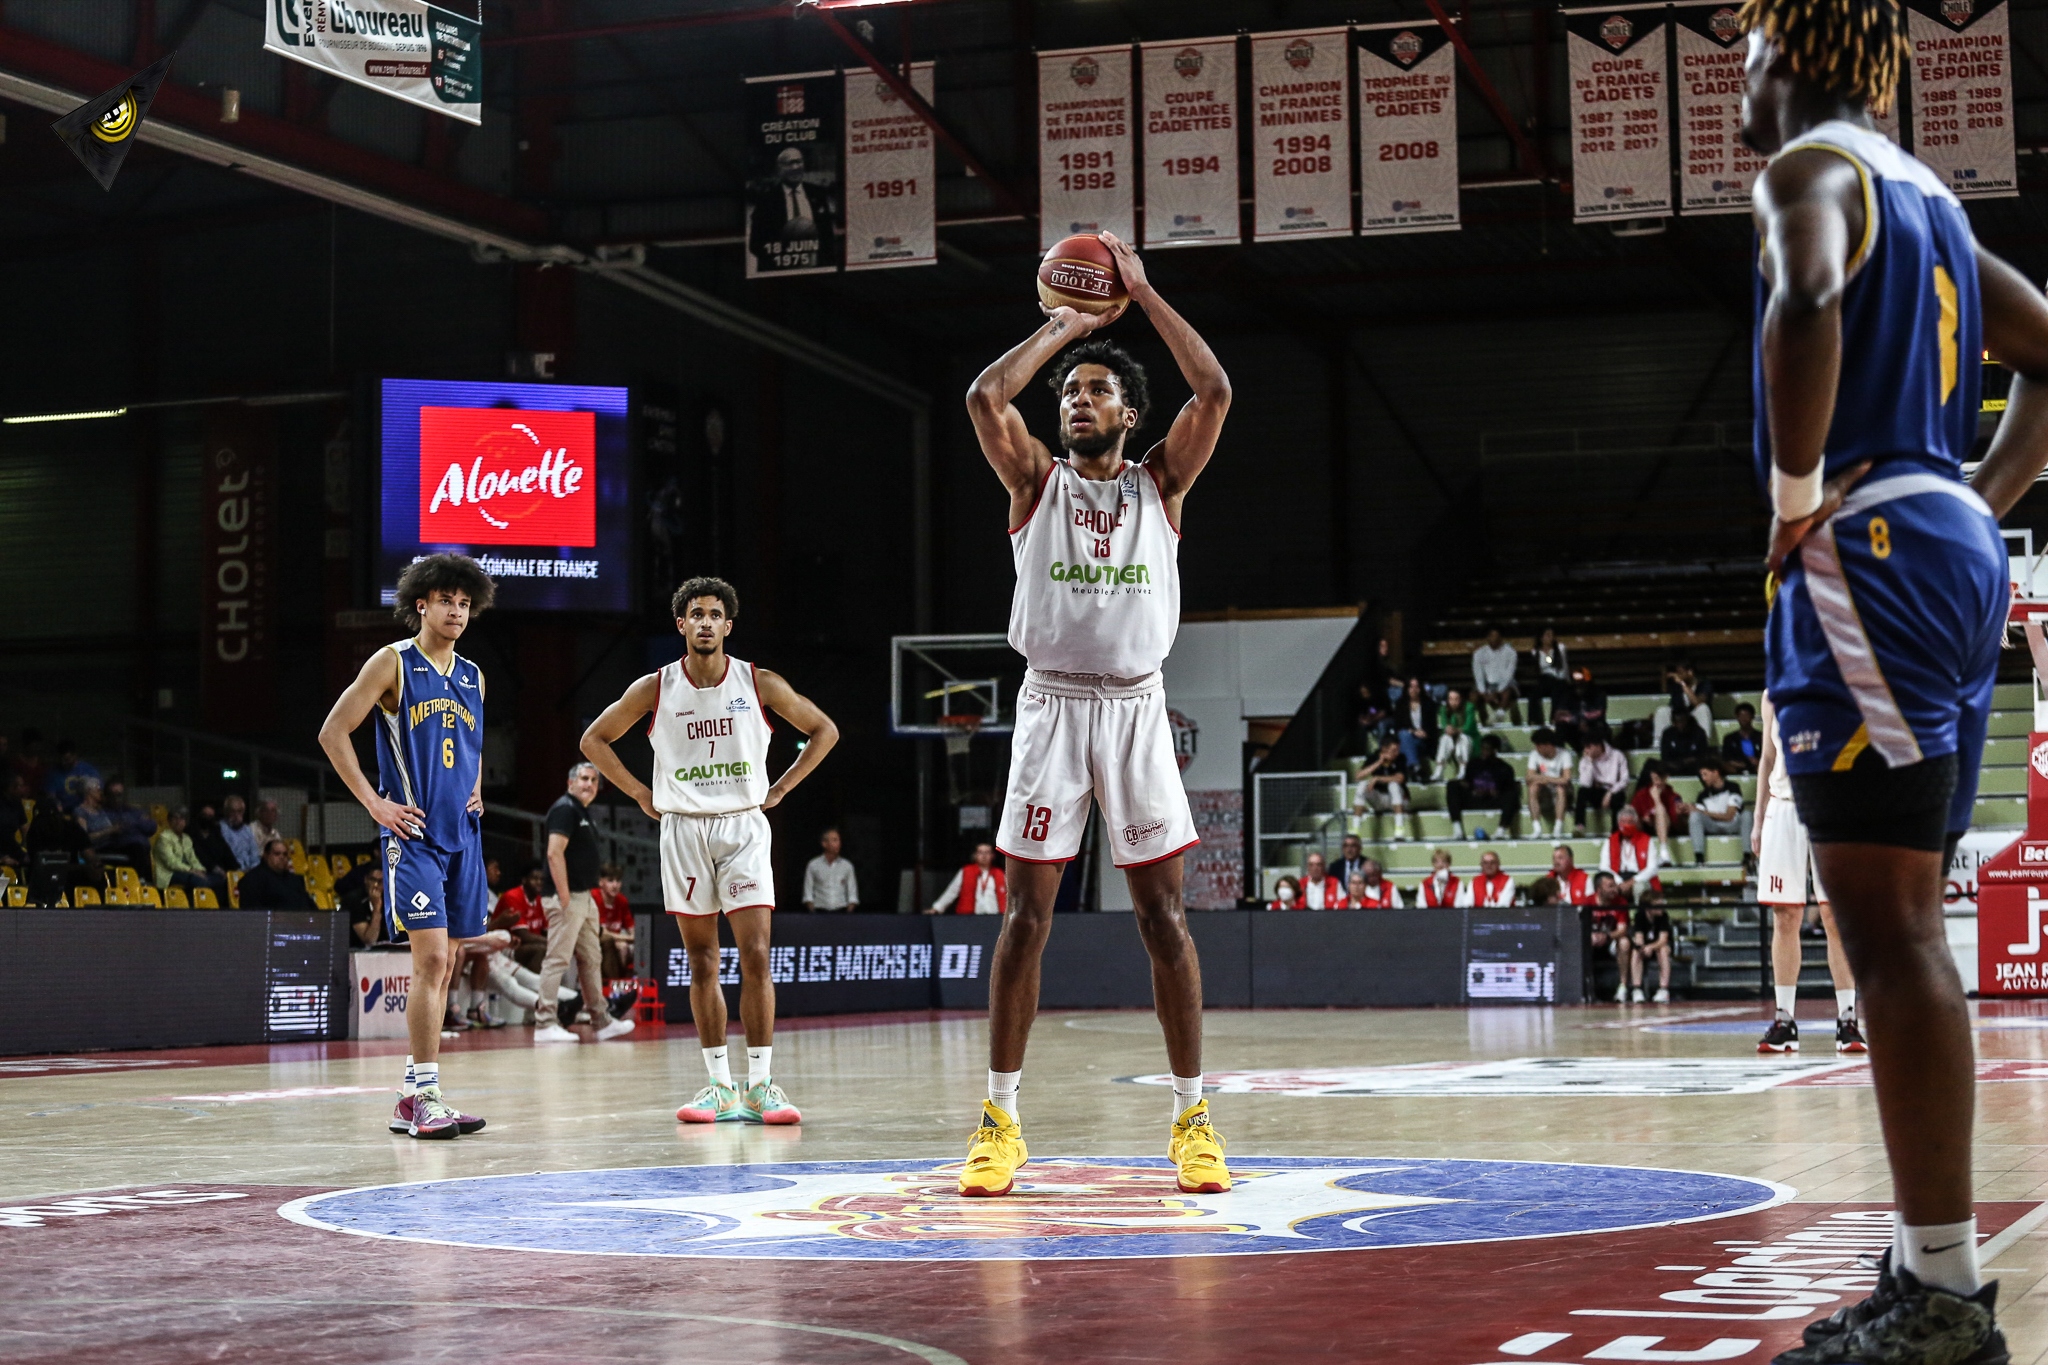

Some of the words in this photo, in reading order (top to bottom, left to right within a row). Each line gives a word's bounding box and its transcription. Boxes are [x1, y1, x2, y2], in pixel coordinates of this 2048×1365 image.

[331, 0, 424, 38] Liboureau
[1916, 35, 2003, 51] CHAMPION
[1592, 59, 1644, 73] COUPE
[1917, 57, 1932, 66] DE
[1938, 50, 2003, 65] FRANCE
[1596, 72, 1661, 87] FRANCE
[1921, 63, 2001, 81] ESPOIRS
[1260, 80, 1341, 97] CHAMPION
[1364, 74, 1429, 89] TROPHÉE
[1165, 91, 1214, 104] COUPE
[1279, 94, 1341, 109] FRANCE
[1366, 87, 1450, 104] PRÉSIDENT
[1583, 86, 1655, 103] CADETS
[1066, 109, 1125, 124] FRANCE
[1169, 104, 1230, 118] FRANCE
[1260, 108, 1342, 126] MINIMES
[1375, 101, 1441, 117] CADETS
[1922, 105, 1957, 117] 1997
[761, 118, 820, 132] CRÉATION
[871, 126, 927, 140] FRANCE
[1047, 123, 1126, 141] MINIMES
[1150, 116, 1232, 134] CADETTES
[1580, 126, 1614, 139] 1997
[1623, 123, 1658, 136] 2001
[1922, 119, 1958, 132] 2010
[1967, 117, 2004, 129] 2018
[765, 133, 780, 144] DU
[785, 131, 816, 142] CLUB
[1273, 134, 1331, 154] 1994
[1623, 138, 1658, 150] 2017
[1923, 134, 1959, 146] 2019
[1379, 141, 1439, 161] 2008
[1689, 148, 1723, 160] 2001
[1058, 151, 1114, 170] 1991
[1162, 156, 1220, 176] 1994
[1273, 156, 1332, 176] 2008
[1689, 163, 1724, 175] 2017
[864, 179, 917, 199] 1991
[1058, 171, 1116, 191] 1992
[787, 240, 819, 252] JUIN
[429, 447, 583, 513] Alouette
[1868, 516, 1891, 560] 8
[1094, 537, 1111, 558] 13
[537, 560, 552, 577] DE
[553, 560, 599, 579] FRANCE
[1050, 562, 1150, 585] GAUTIER
[409, 698, 476, 732] METROPOLITANS
[442, 713, 455, 729] 92
[687, 718, 733, 740] CHOLET
[442, 738, 454, 769] 6
[708, 741, 715, 758] 7
[675, 761, 752, 781] GAUTIER
[1022, 803, 1051, 842] 13
[1126, 829, 1139, 842] CB
[686, 877, 696, 901] 7
[1770, 875, 1783, 894] 14
[798, 946, 832, 982] LES
[835, 944, 907, 981] MATCHS
[909, 944, 932, 978] EN
[1996, 962, 2034, 981] JEAN
[384, 995, 407, 1013] SPO
[1187, 1113, 1208, 1127] UNO
